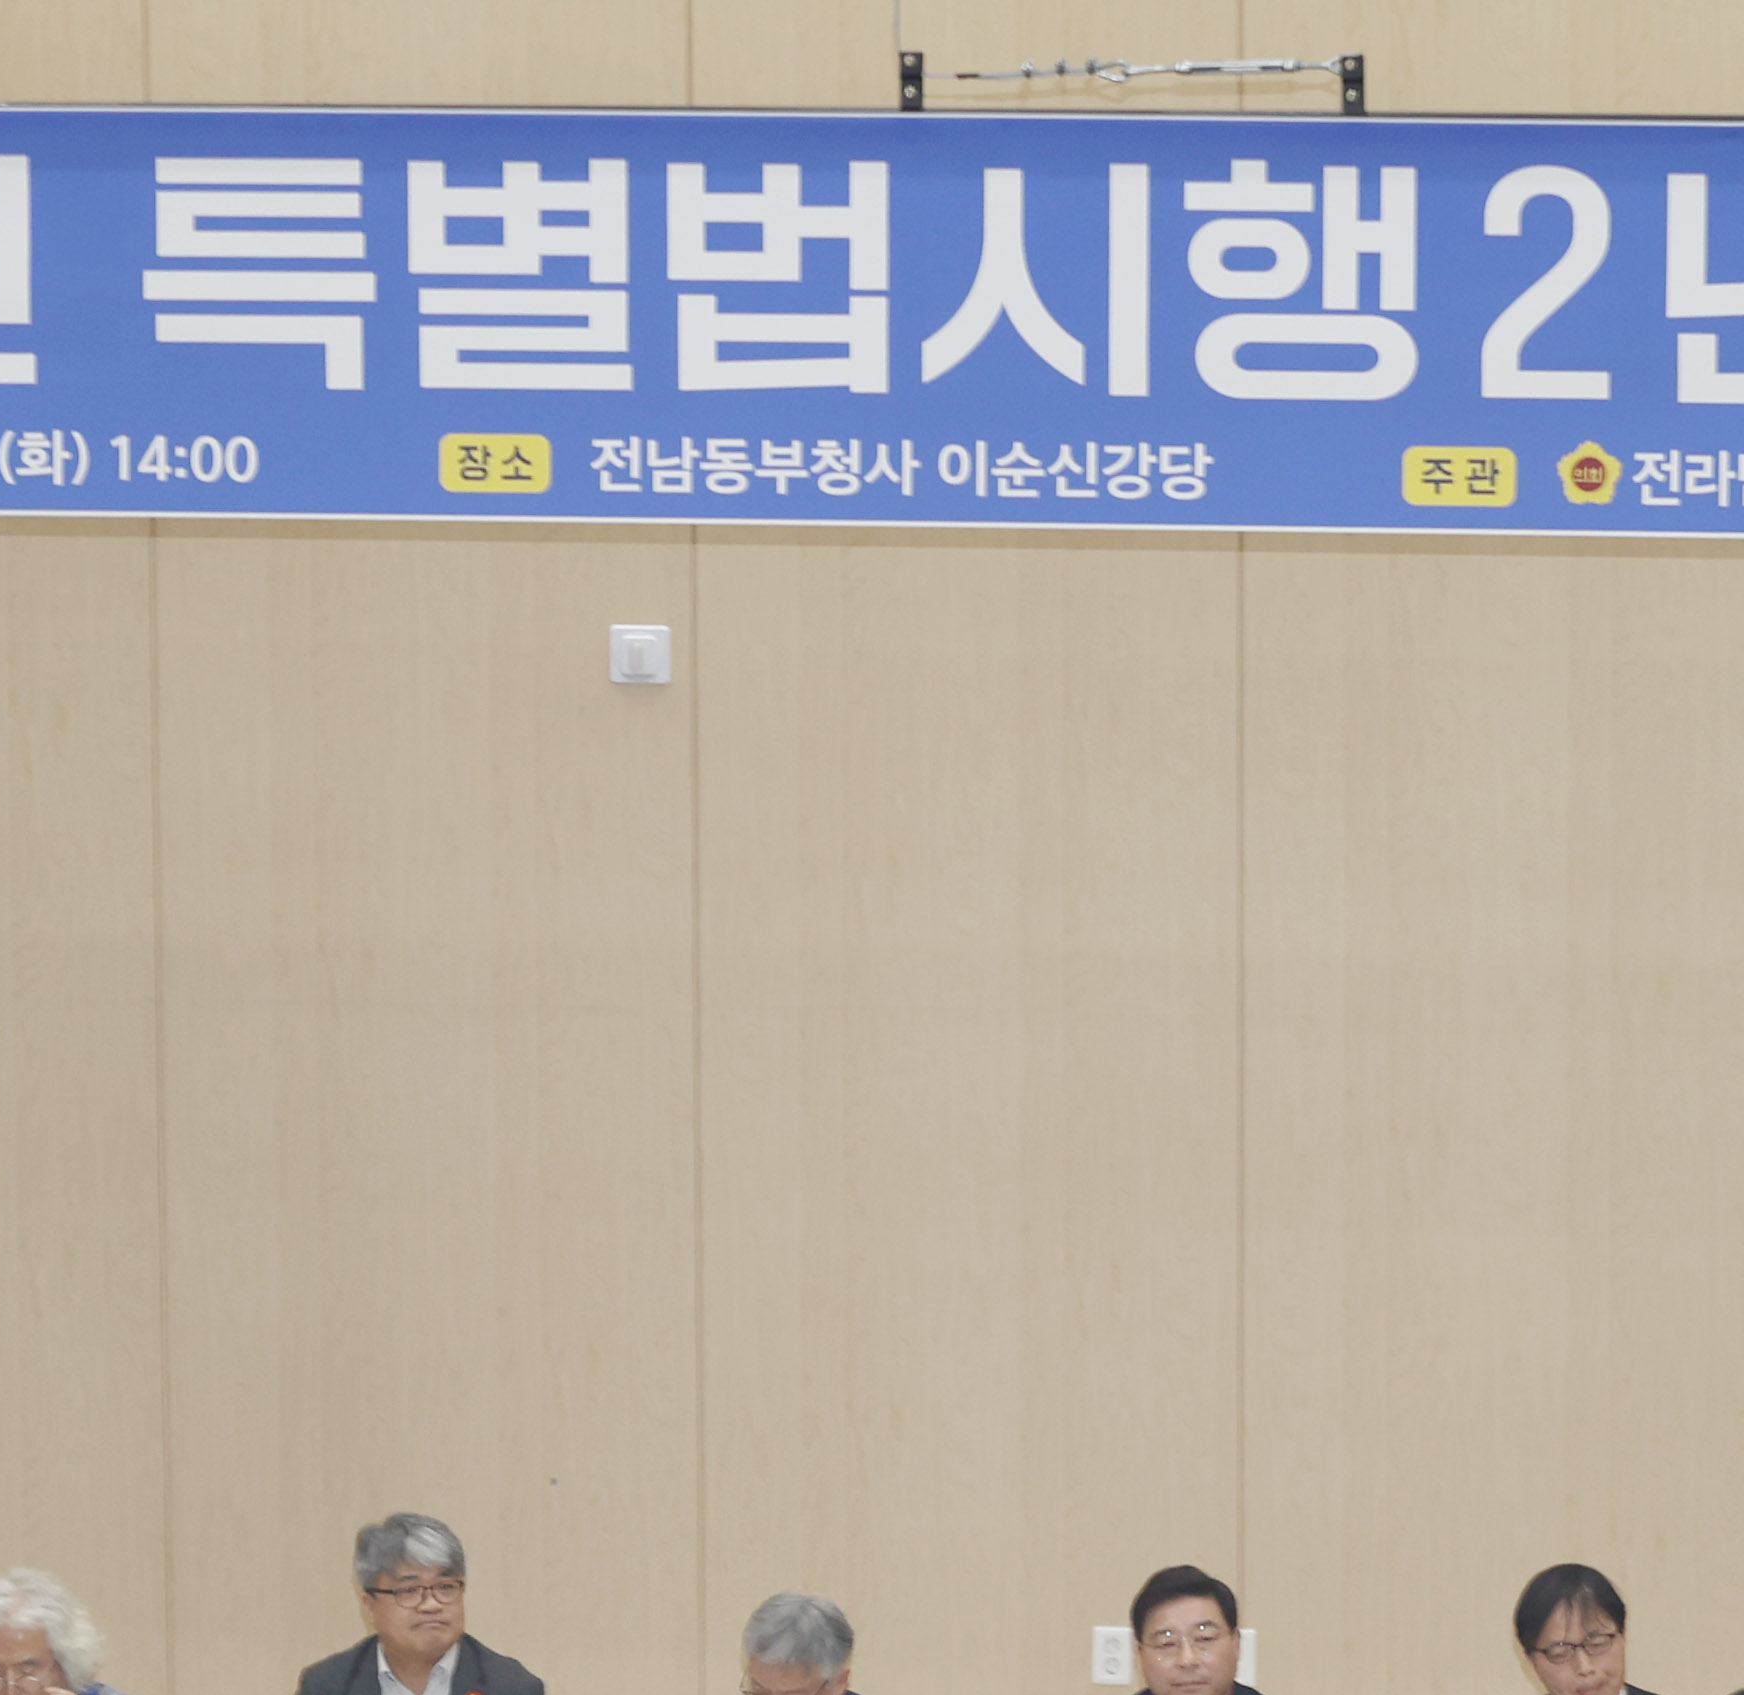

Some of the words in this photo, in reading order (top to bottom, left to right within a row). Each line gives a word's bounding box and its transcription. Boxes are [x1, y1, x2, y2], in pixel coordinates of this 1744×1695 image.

[143, 157, 1418, 401] 특별법시행
[110, 435, 259, 483] 14:00
[458, 445, 533, 482] 장소
[590, 436, 922, 497] 전남동부청사
[937, 440, 1214, 501] 이순신강당
[1421, 459, 1500, 495] 주관
